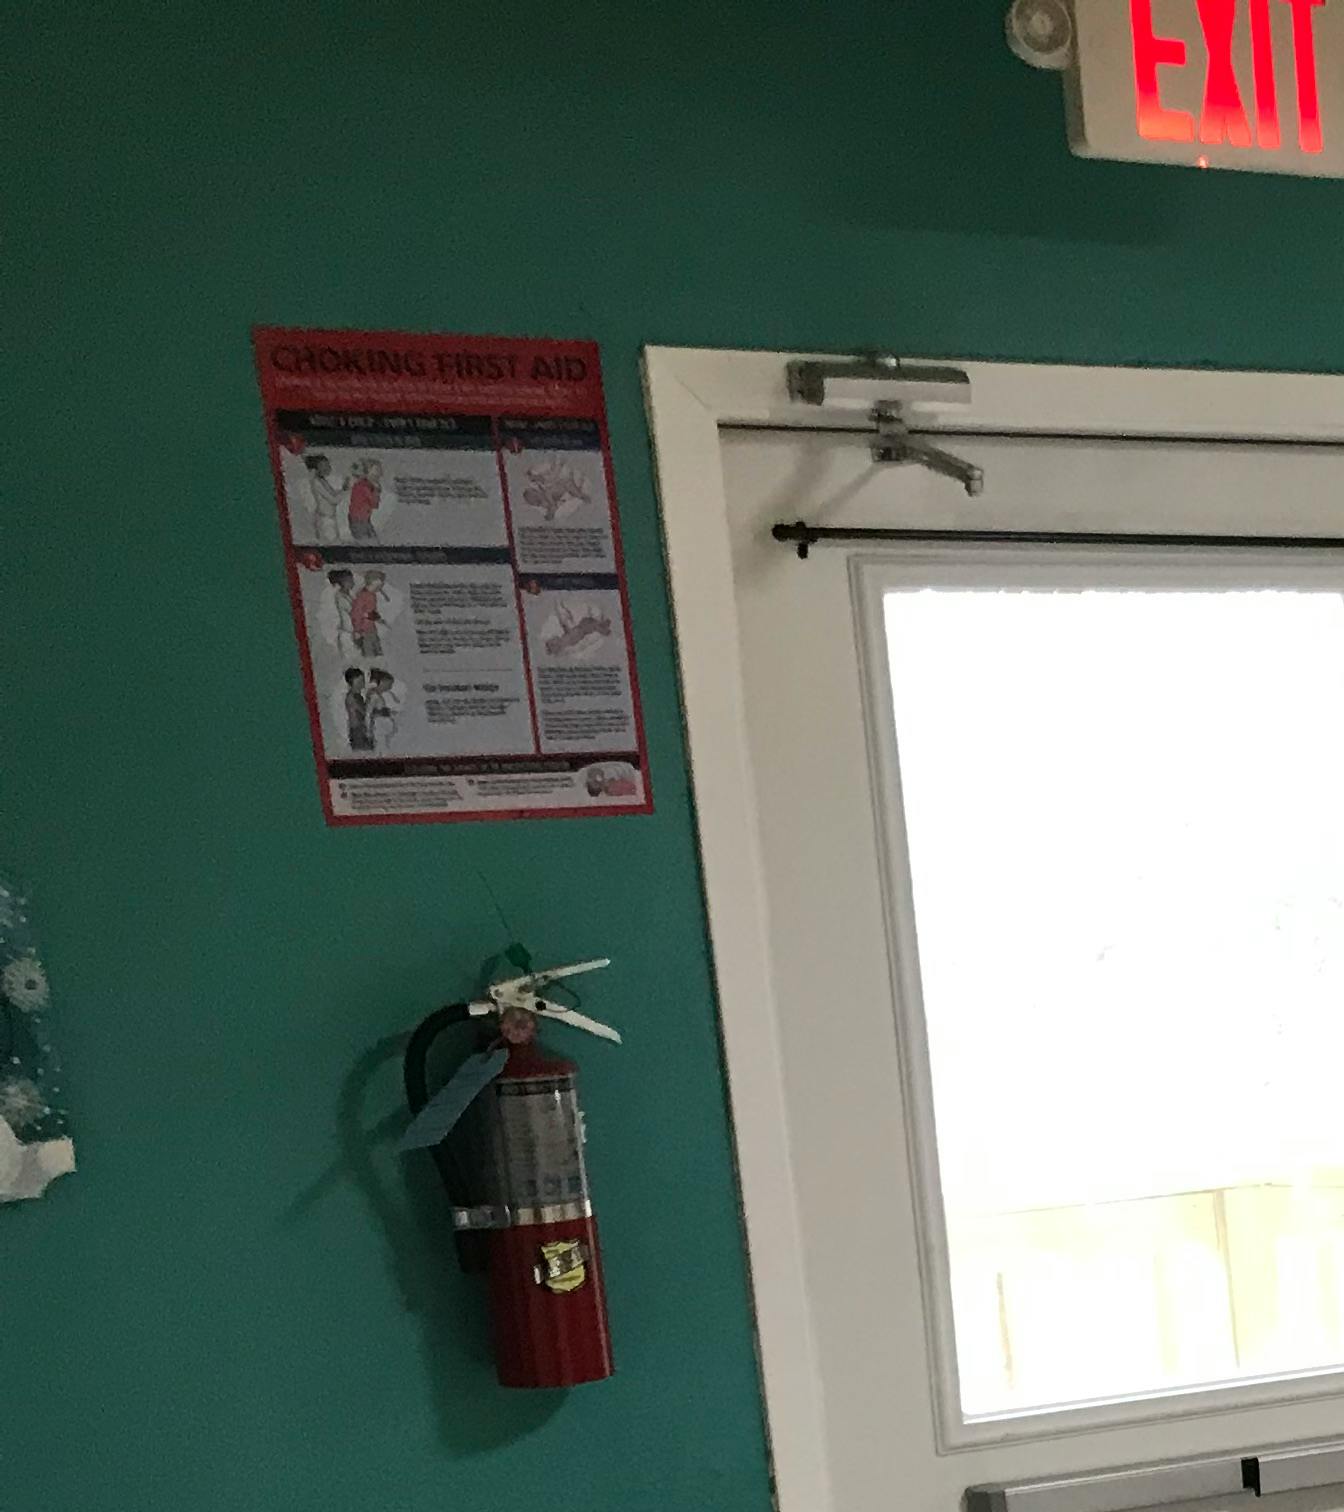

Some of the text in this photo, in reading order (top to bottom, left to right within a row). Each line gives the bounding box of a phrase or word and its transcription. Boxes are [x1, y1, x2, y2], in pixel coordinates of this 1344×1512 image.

[1130, 0, 1324, 153] EXIT
[270, 345, 587, 381] CHOKING FIRST AID
